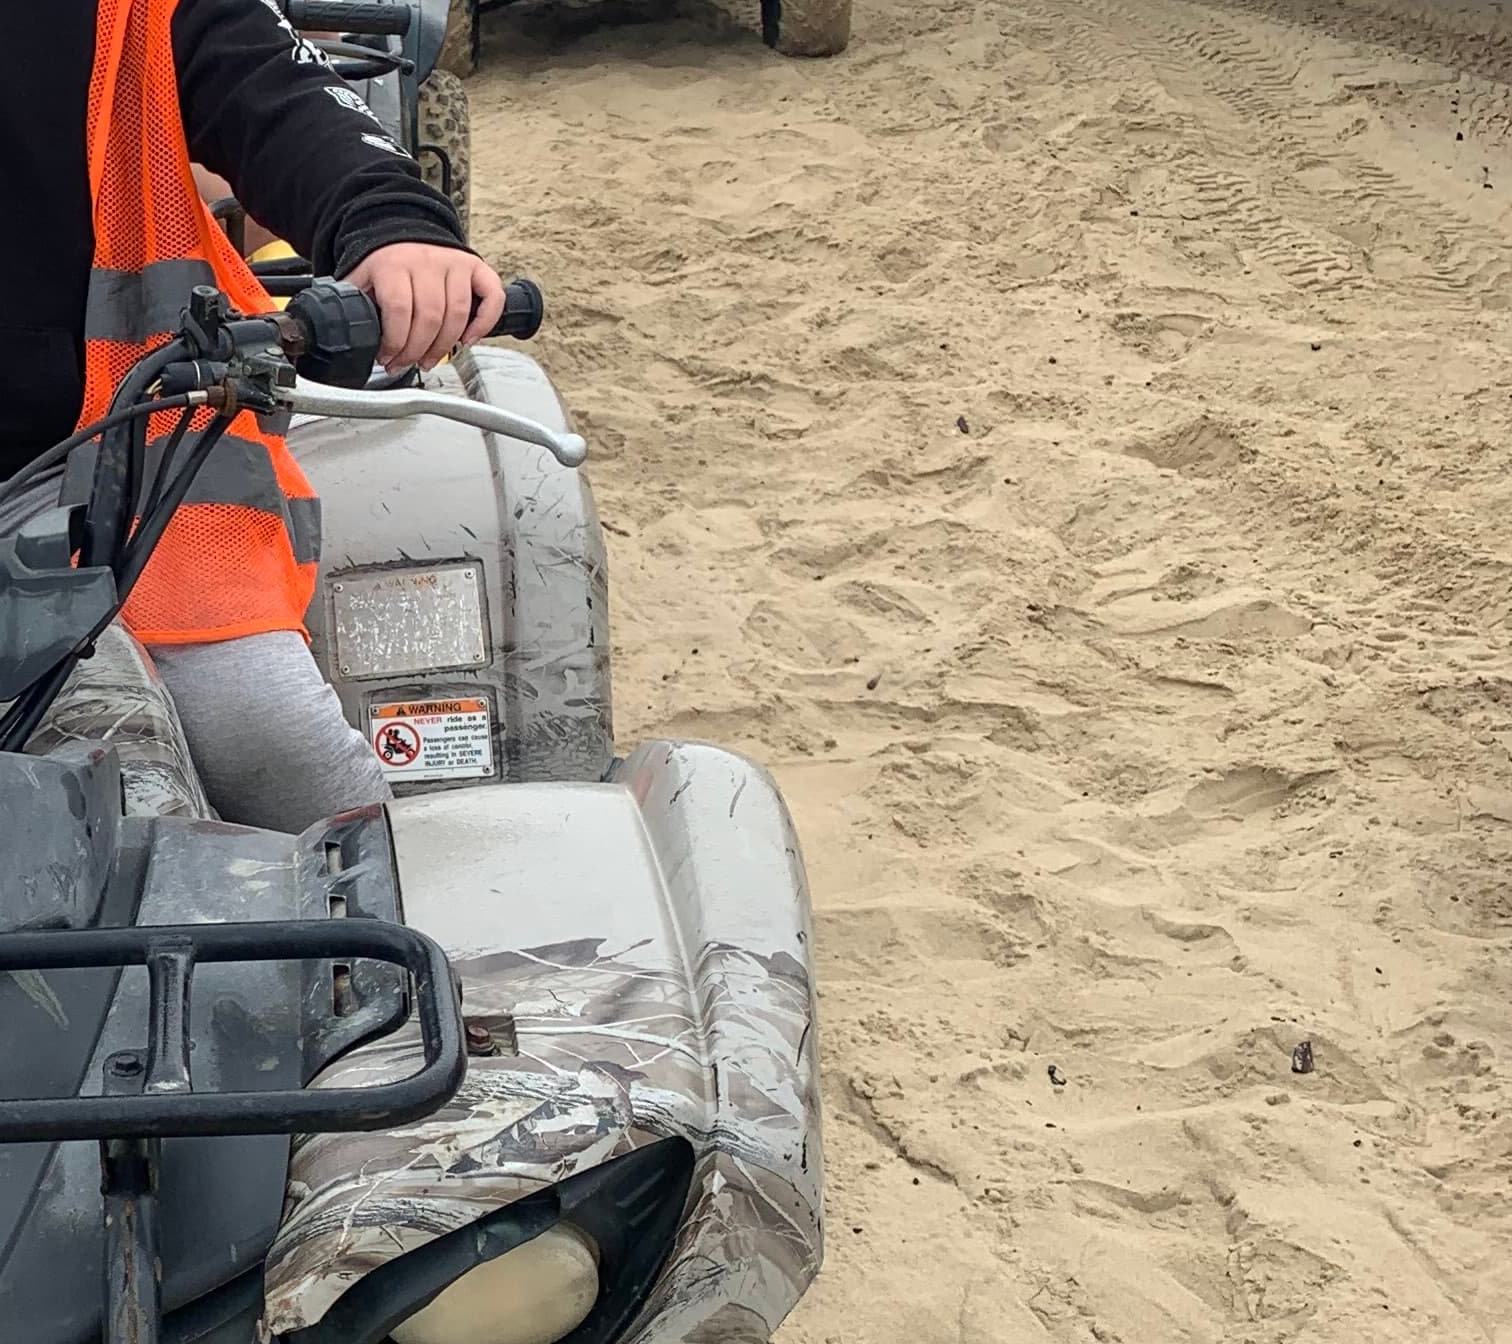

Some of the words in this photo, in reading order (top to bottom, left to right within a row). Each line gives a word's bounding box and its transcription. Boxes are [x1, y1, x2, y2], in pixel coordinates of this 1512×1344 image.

[408, 702, 462, 715] WARNING
[414, 717, 442, 725] NEVER
[459, 749, 482, 757] SEVERE
